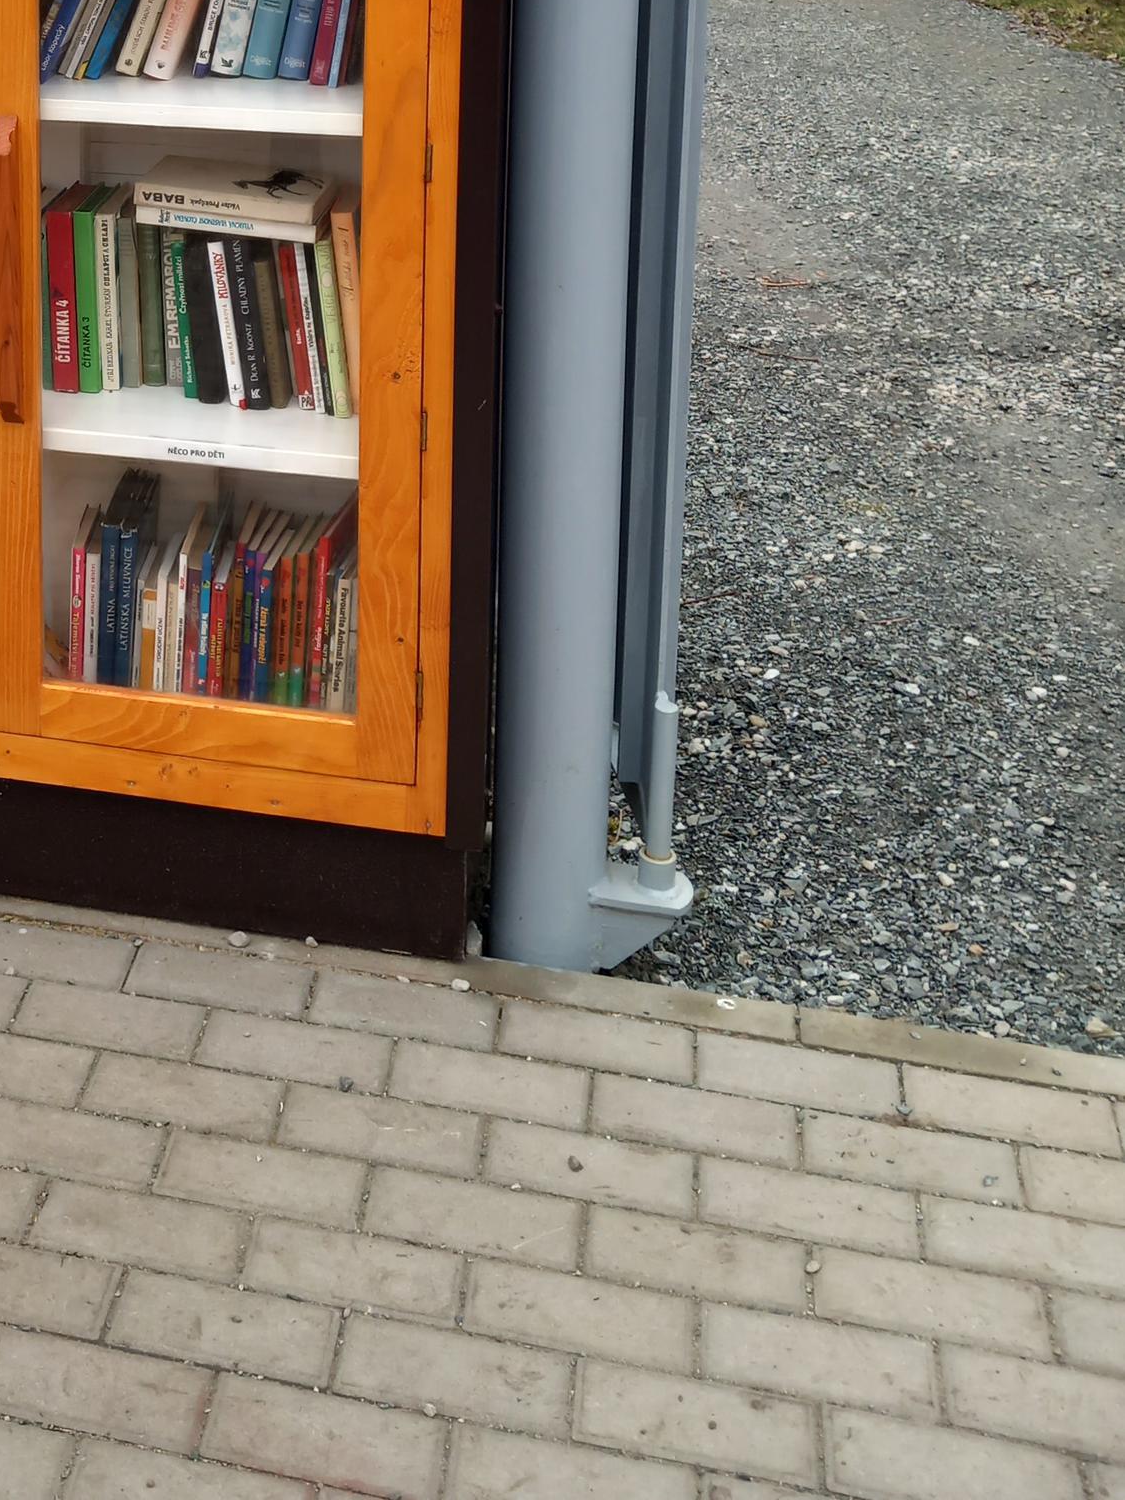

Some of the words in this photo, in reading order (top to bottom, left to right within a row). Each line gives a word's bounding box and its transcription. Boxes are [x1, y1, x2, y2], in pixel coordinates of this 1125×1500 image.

[207, 13, 219, 31] BRUCE
[48, 24, 66, 54] Kopecký
[141, 191, 185, 205] BABA
[221, 202, 241, 212] Václav
[212, 251, 229, 299] MILOVÁNKY
[55, 299, 69, 308] 4
[54, 309, 70, 363] ČÍTANKA
[81, 325, 91, 368] ČÍTANKA
[244, 323, 256, 351] KOONTZ
[249, 363, 259, 382] DEAN
[167, 446, 188, 456] NĚCO
[190, 449, 206, 457] PRO
[208, 450, 225, 459] DĚTI
[122, 546, 134, 597] MLUVNICE
[106, 598, 116, 634] LATINA
[338, 587, 350, 628] Favourite
[72, 611, 80, 655] Tajemství
[119, 600, 131, 651] LATINSKÁ
[336, 629, 347, 660] Animal
